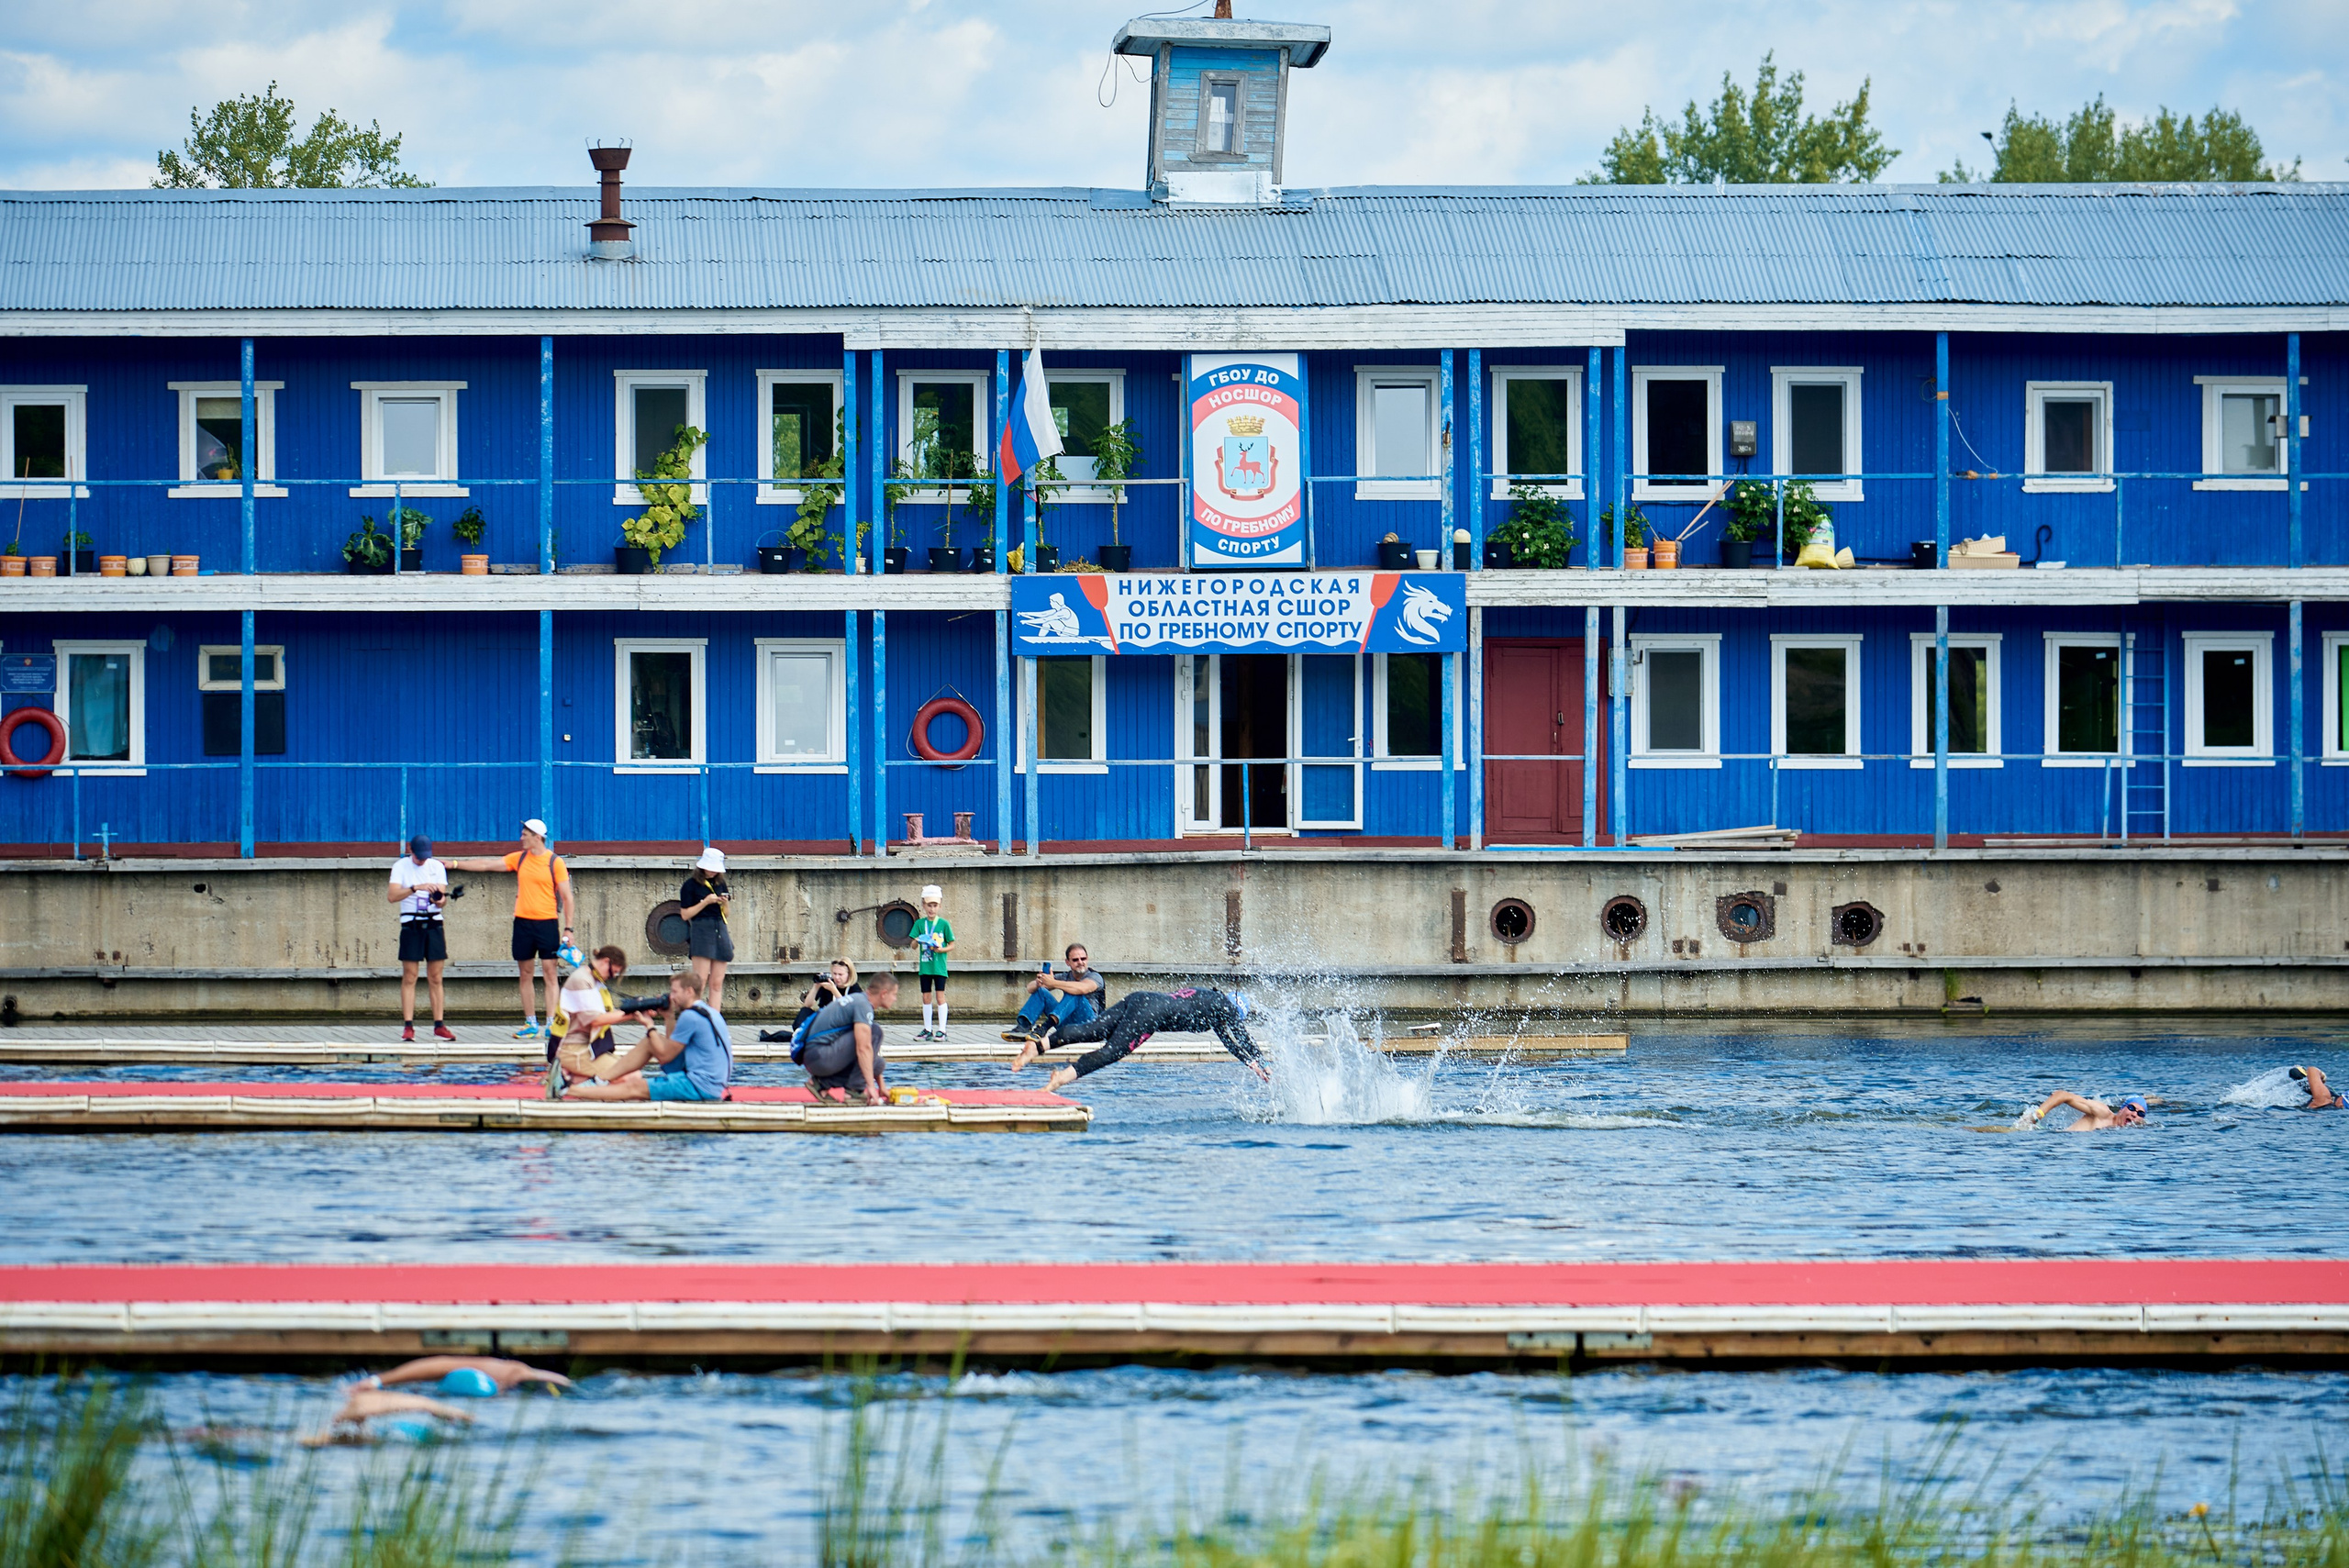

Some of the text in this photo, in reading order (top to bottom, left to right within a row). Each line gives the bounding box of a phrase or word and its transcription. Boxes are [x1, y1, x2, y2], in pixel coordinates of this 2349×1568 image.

[1208, 369, 1280, 386] ГБОУ ДО
[1208, 388, 1283, 409] НОСШОР
[1200, 504, 1296, 534] ПО ГРЕБНОМУ
[1218, 536, 1280, 554] СПОРТУ
[1119, 578, 1360, 596] НИЖЕГОРОДСКАЯ
[1128, 598, 1351, 617] ОБЛАСТНАЯ СШОР
[1119, 621, 1363, 639] ПО ГРЕБНОМУ СПОРТУ
